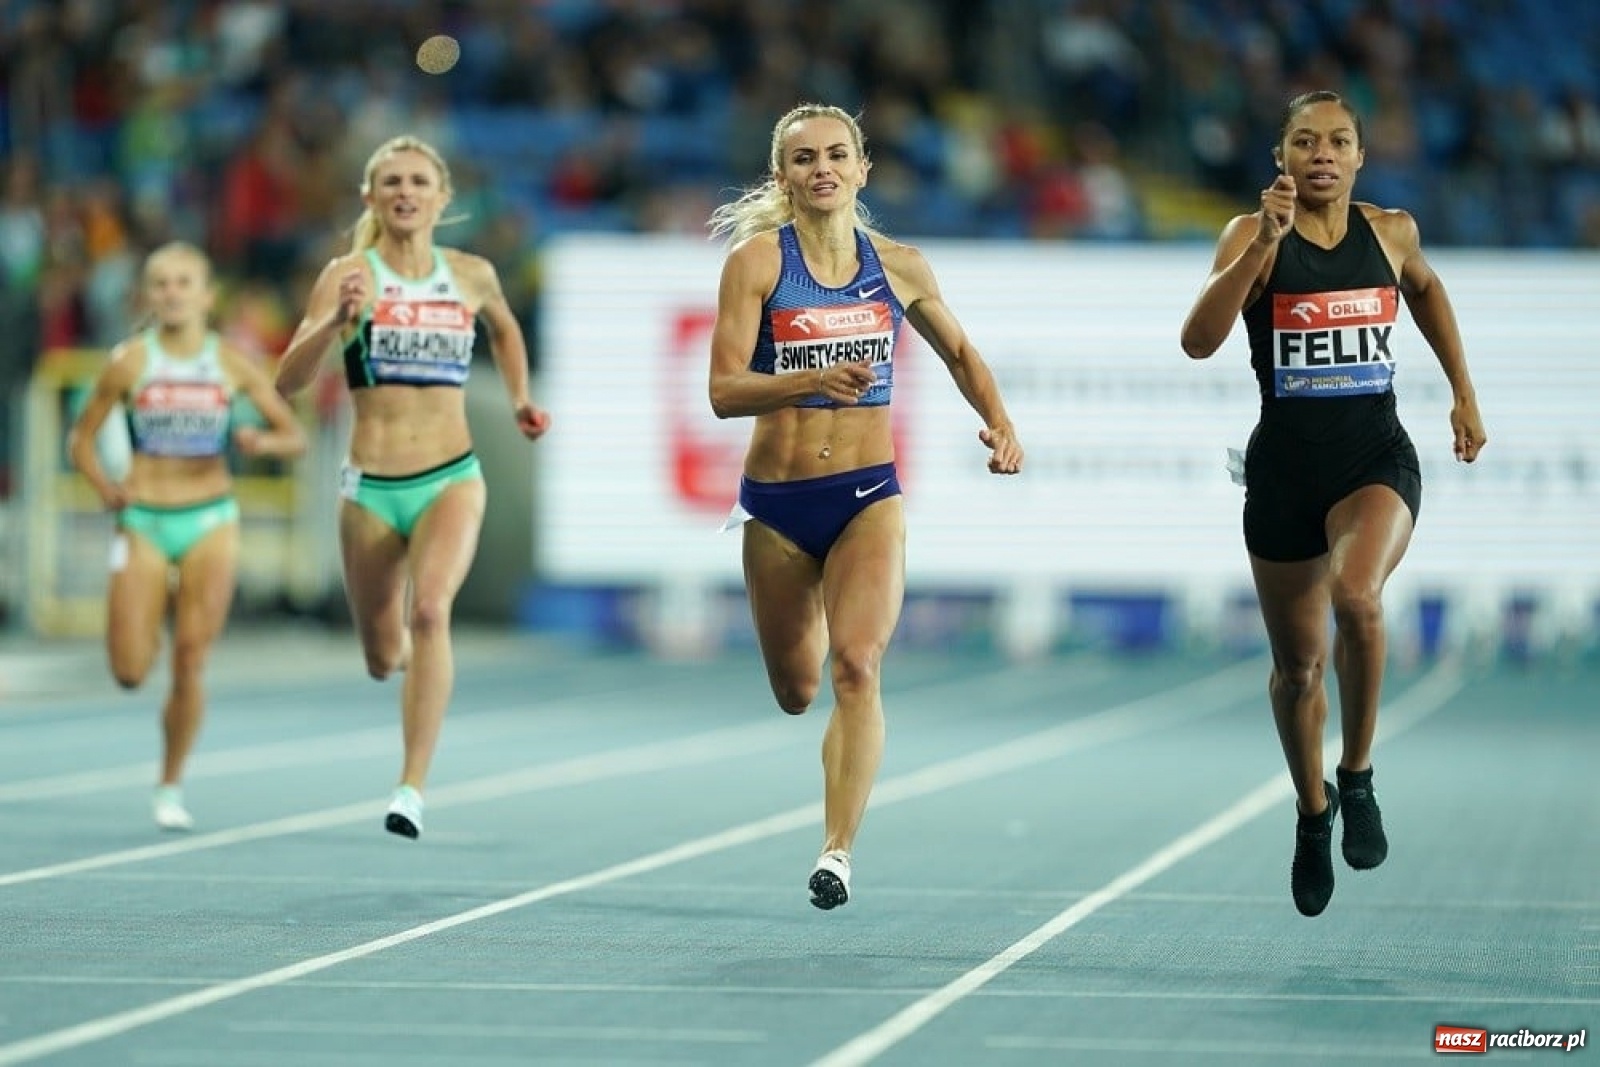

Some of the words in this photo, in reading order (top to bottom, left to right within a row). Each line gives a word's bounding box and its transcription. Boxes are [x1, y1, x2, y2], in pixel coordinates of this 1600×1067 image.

[1331, 301, 1378, 316] ORLEN
[828, 312, 871, 328] ORLEN
[1280, 326, 1393, 366] FELIX
